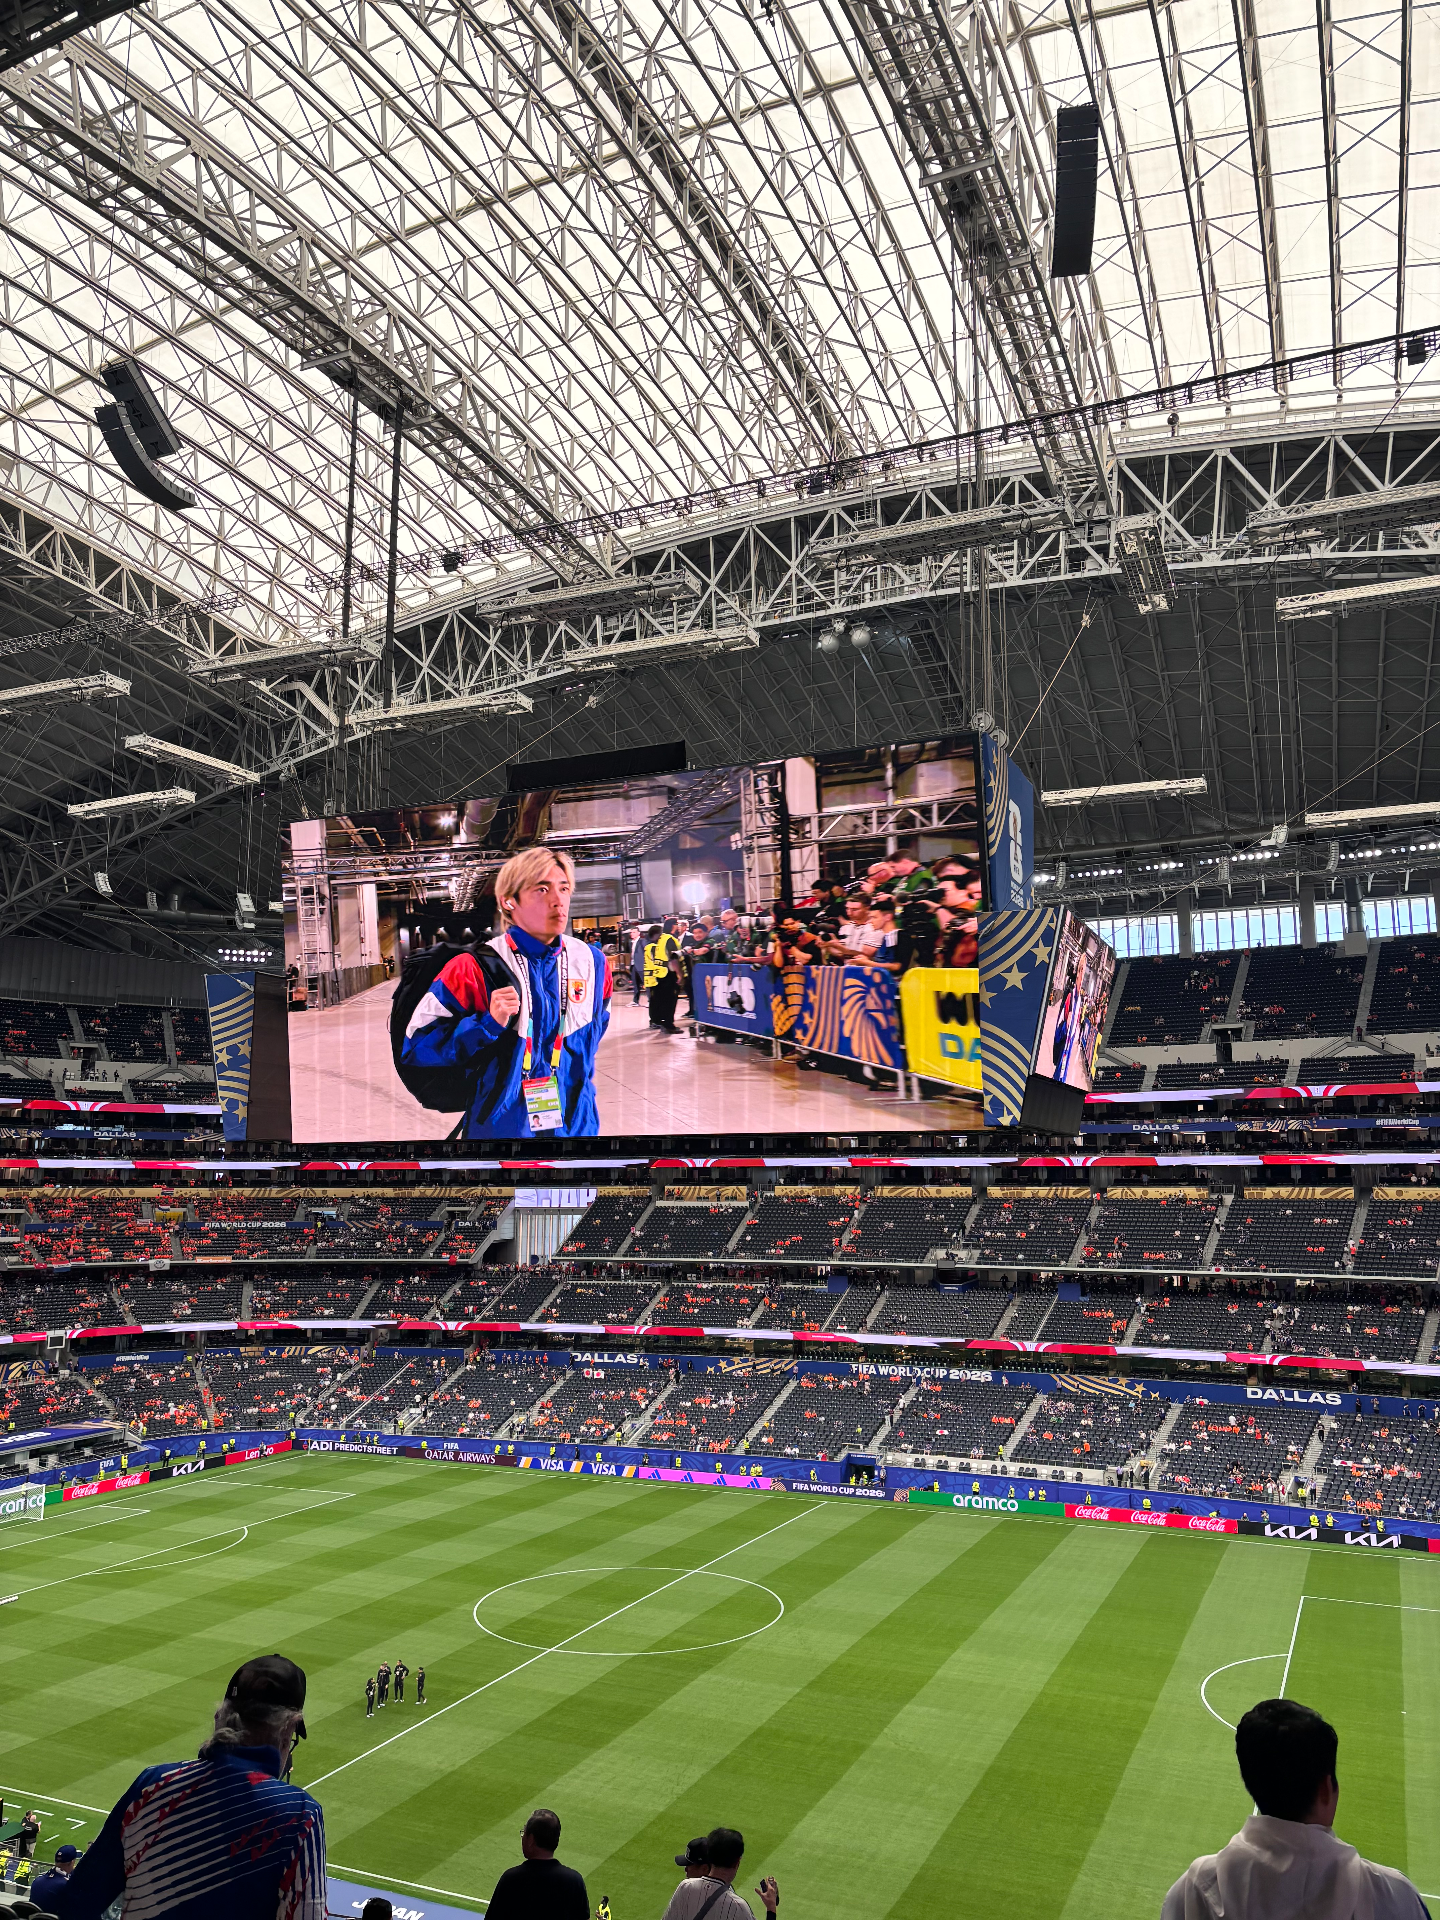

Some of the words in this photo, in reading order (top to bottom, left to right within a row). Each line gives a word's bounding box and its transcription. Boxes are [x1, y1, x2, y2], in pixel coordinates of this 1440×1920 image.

[573, 1352, 638, 1364] DALLAS
[851, 1364, 877, 1375] FIFA
[877, 1365, 921, 1377] WORLD
[923, 1367, 948, 1378] CUP
[948, 1369, 993, 1382] 2026
[1245, 1387, 1342, 1406] DALLAS
[245, 1446, 274, 1460] Lenvo
[310, 1441, 333, 1451] ADI
[334, 1443, 398, 1455] PREDICTSTREET
[443, 1442, 460, 1450] FIFA
[100, 1459, 114, 1468] FIFA
[424, 1449, 455, 1461] QATAR
[457, 1452, 496, 1464] AIRWAYS
[539, 1459, 565, 1472] VISA
[590, 1462, 617, 1476] VISA
[71, 1482, 100, 1499] Coca-Cola
[792, 1482, 809, 1491] FIFA
[810, 1484, 838, 1494] WORLD
[839, 1485, 855, 1495] CUP
[855, 1488, 884, 1498] 2026
[952, 1494, 1019, 1512] aramco
[1074, 1506, 1111, 1521] Coca-Cola
[1131, 1511, 1168, 1526] Coca-Cola
[1188, 1515, 1227, 1532] Coca-Cola
[351, 1898, 425, 1920] JAN
